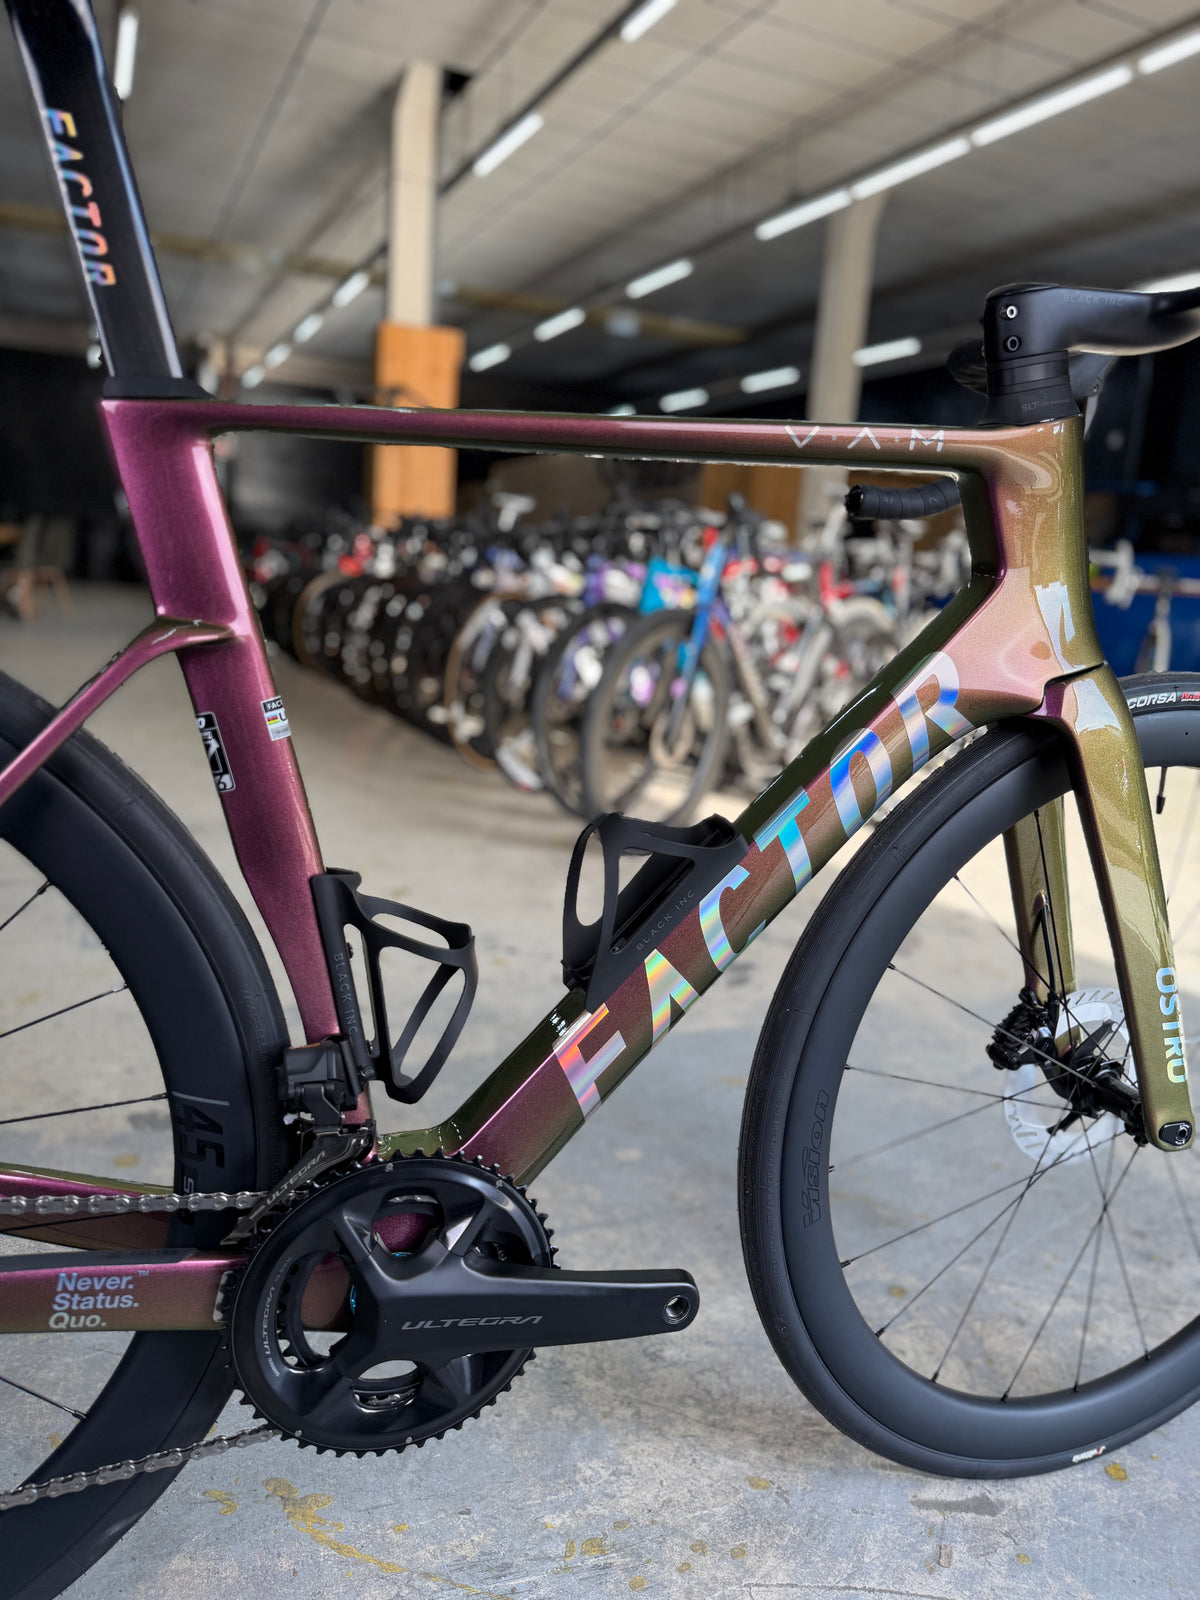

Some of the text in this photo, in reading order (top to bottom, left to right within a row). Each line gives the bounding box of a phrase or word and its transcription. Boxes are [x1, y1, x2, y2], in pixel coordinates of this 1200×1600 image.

[1127, 691, 1177, 709] CORSA
[552, 650, 975, 1119] FACTOR
[636, 889, 696, 951] BLACK INC
[334, 952, 358, 1035] BLACK INC
[266, 1150, 326, 1205] ULTEGRA
[802, 1088, 830, 1230] Vision
[52, 1293, 140, 1311] Status.
[56, 1272, 135, 1292] Never.
[49, 1312, 107, 1329] Quo.
[262, 1286, 276, 1355] ULTEGRA
[401, 1315, 544, 1330] ULTEGRA
